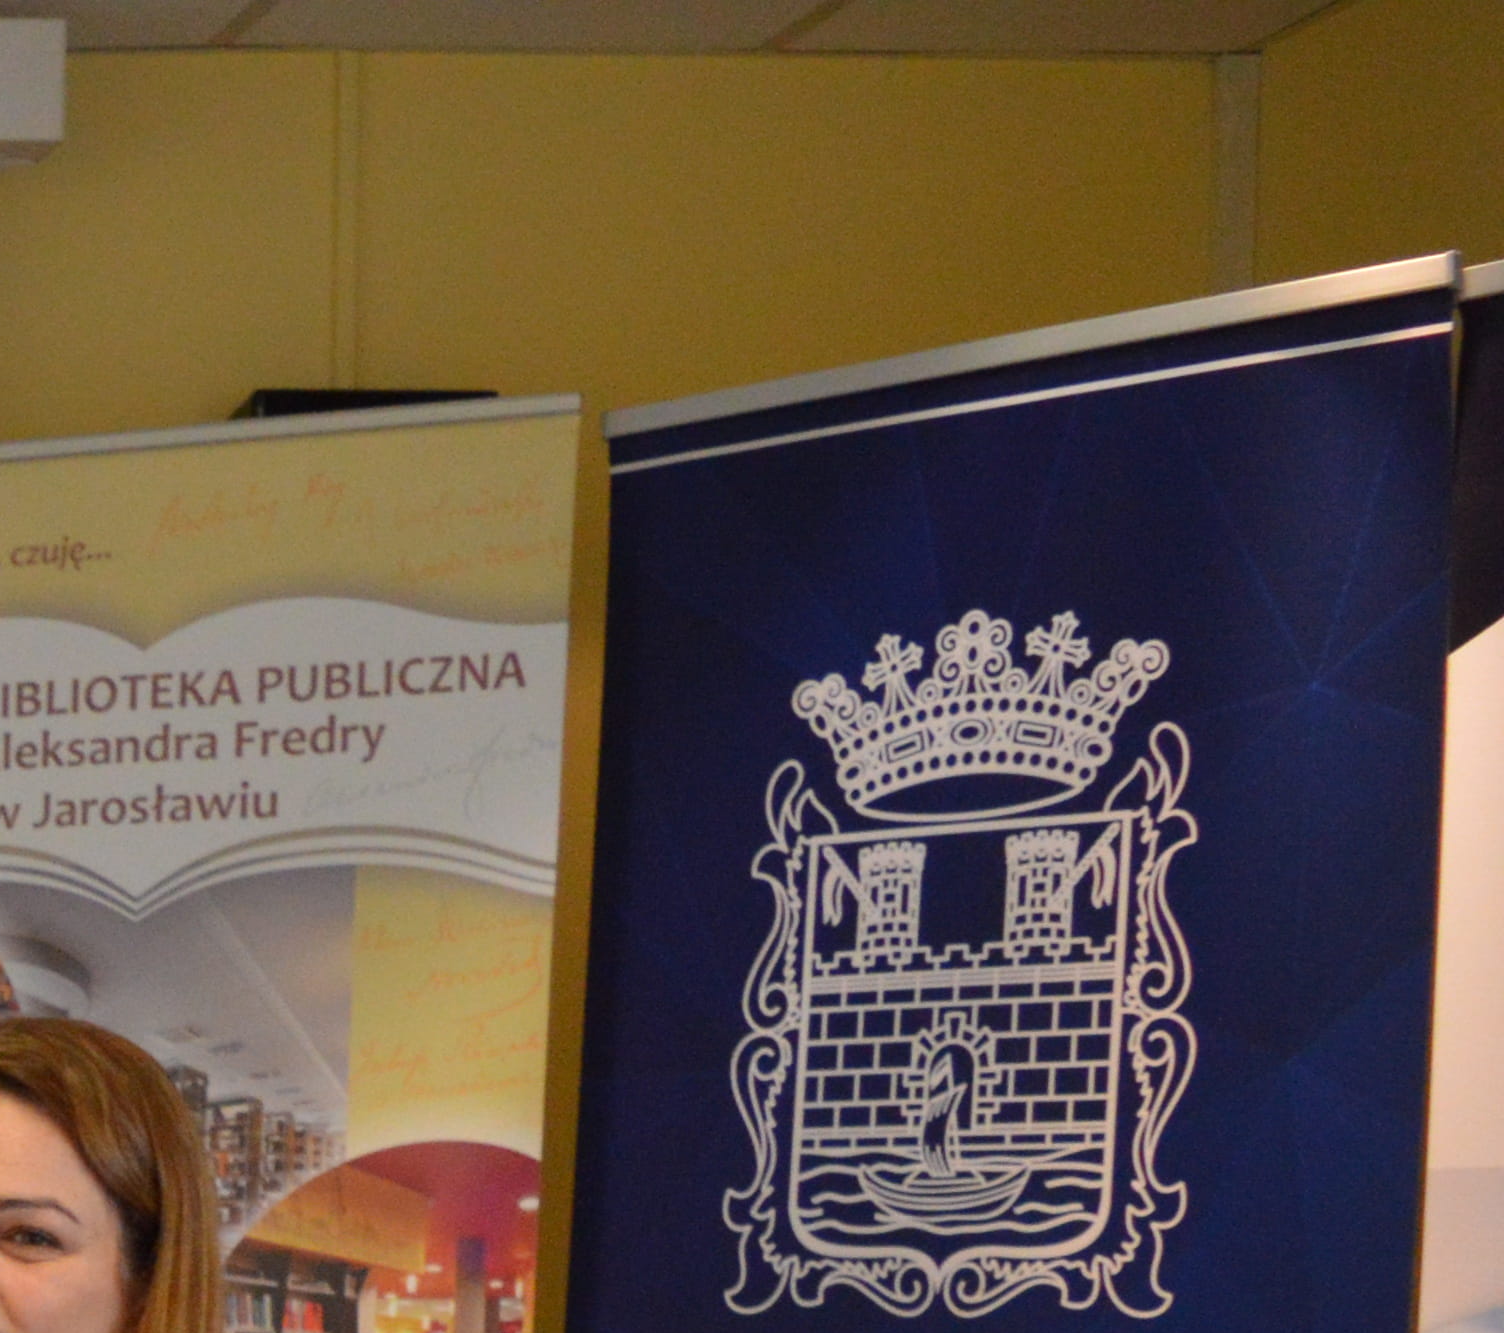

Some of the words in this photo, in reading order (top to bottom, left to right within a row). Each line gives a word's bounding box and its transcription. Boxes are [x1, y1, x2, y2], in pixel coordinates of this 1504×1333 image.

[9, 537, 112, 573] czuję...
[256, 651, 527, 704] PUBLICZNA
[234, 715, 386, 763] Fredry
[32, 782, 280, 831] Jarosławiu
